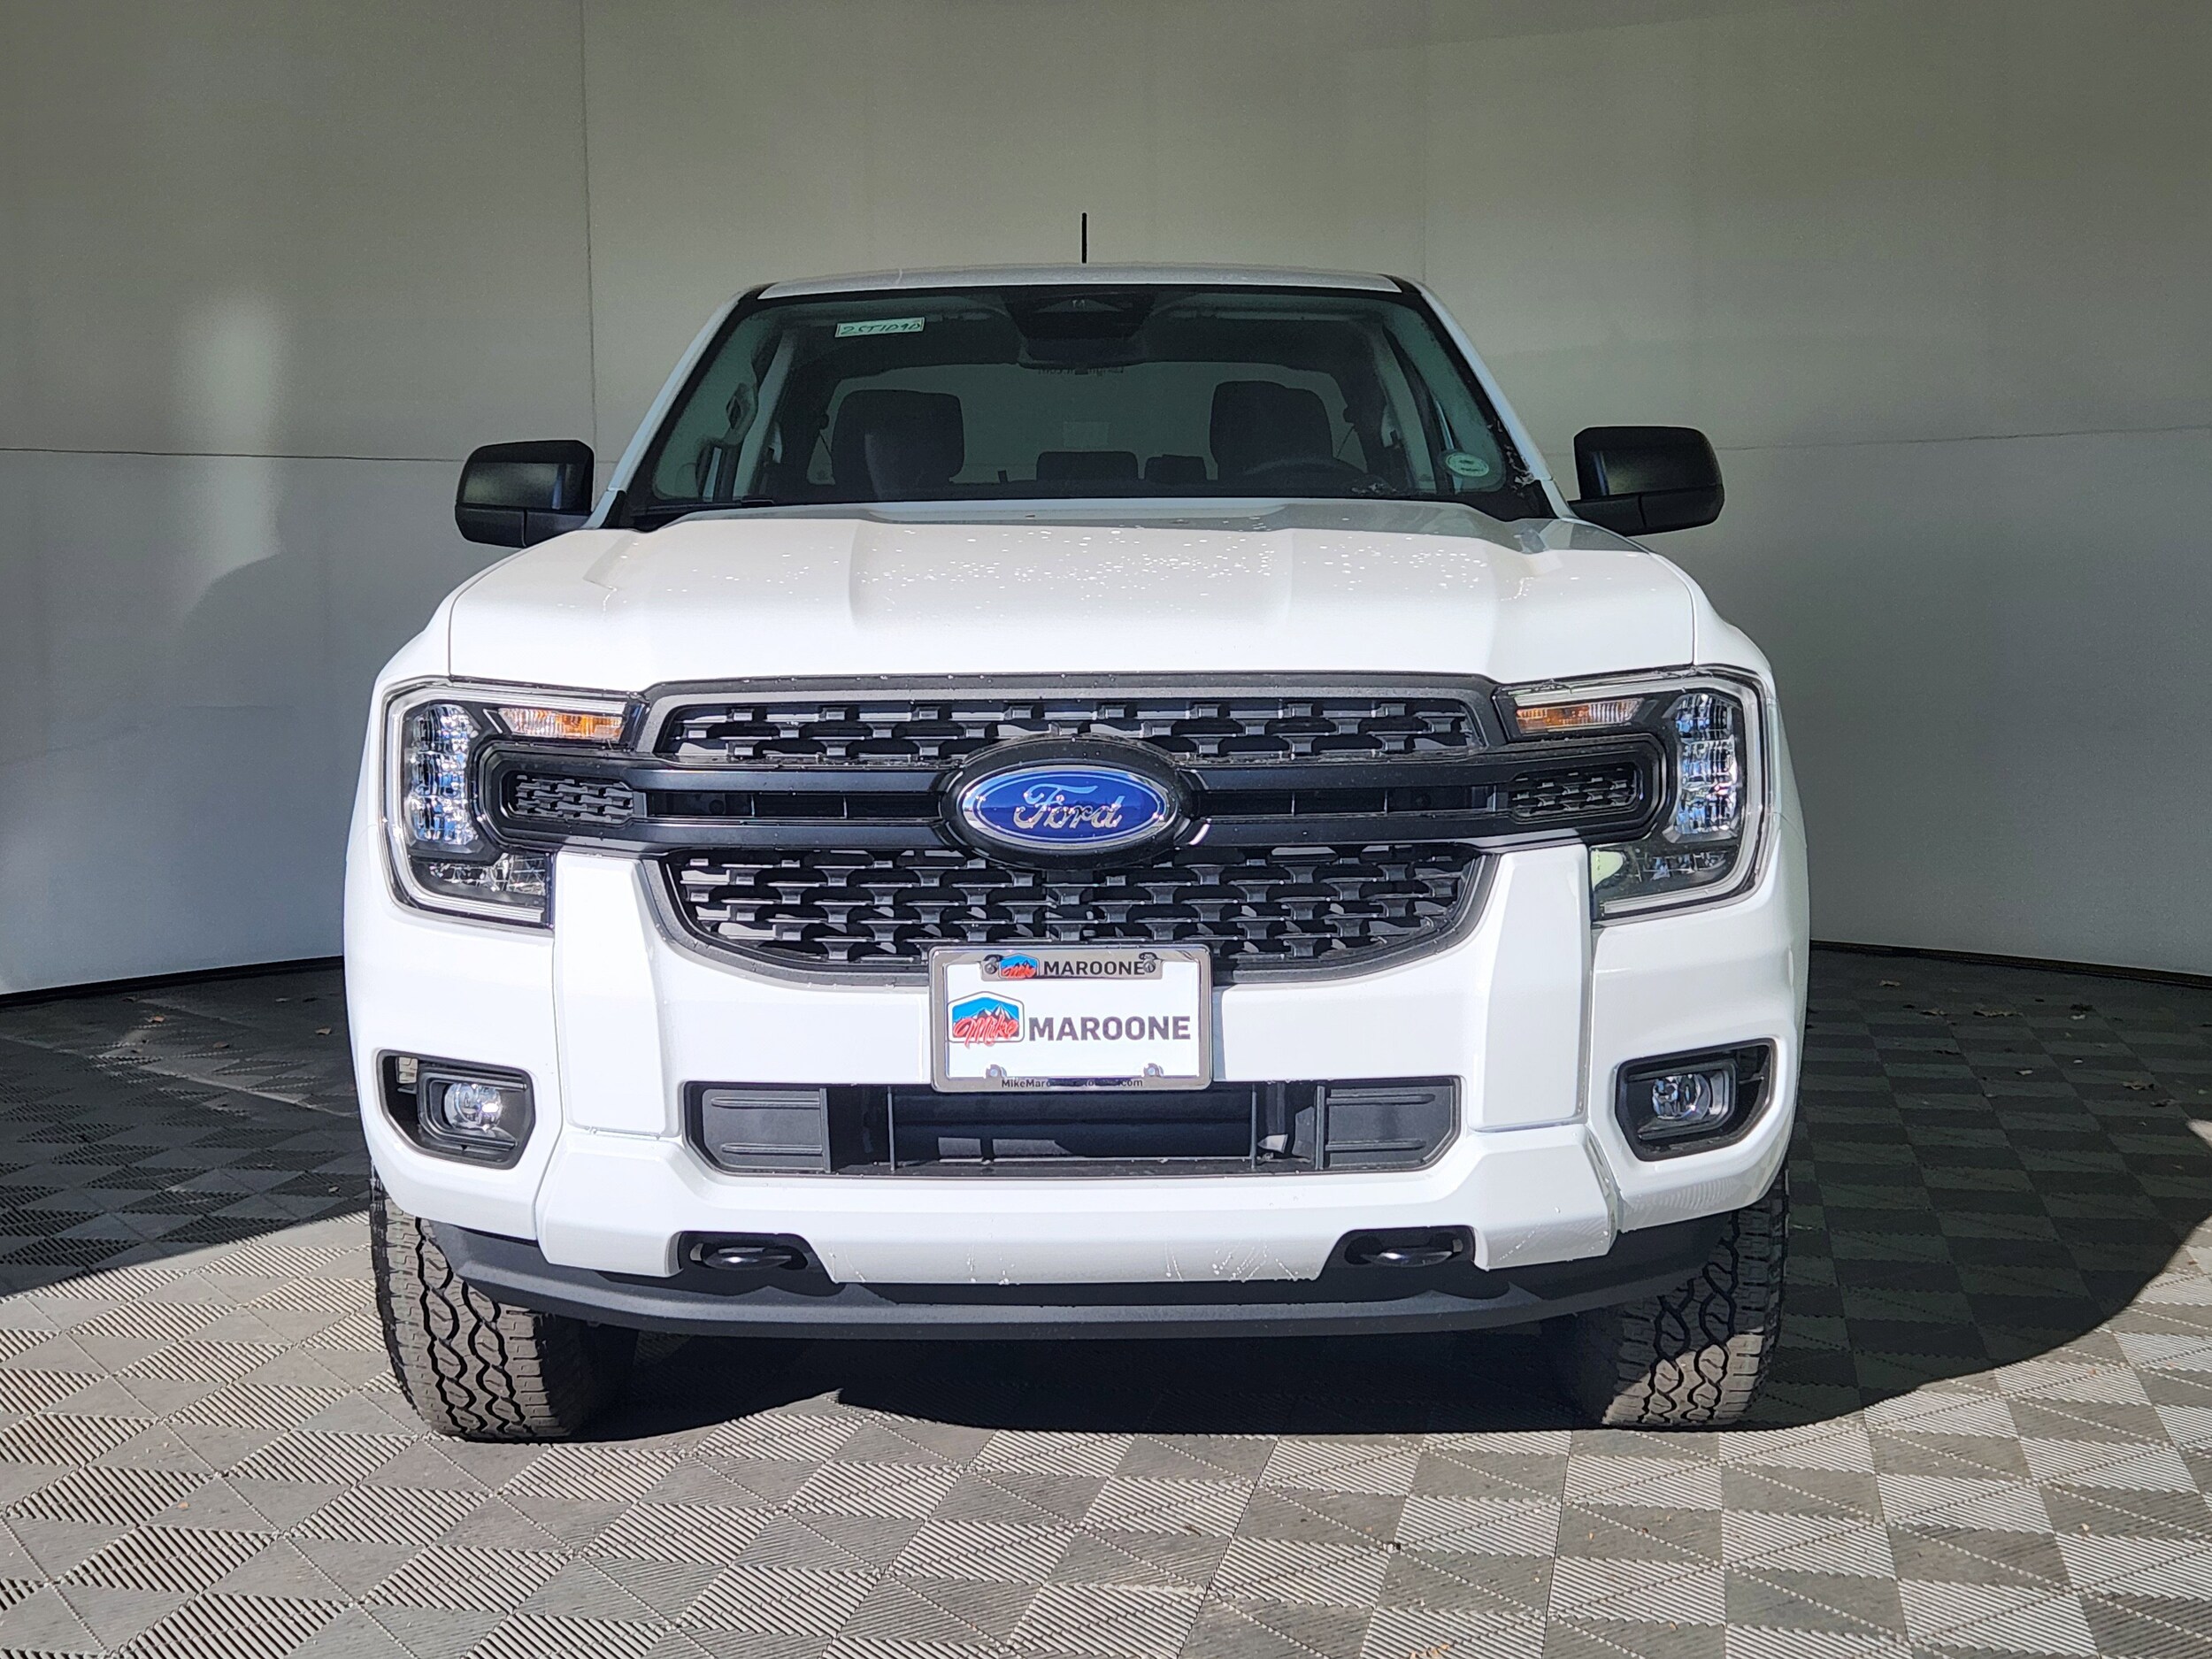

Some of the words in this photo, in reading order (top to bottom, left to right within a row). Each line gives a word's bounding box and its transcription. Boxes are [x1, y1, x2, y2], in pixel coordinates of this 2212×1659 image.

[1013, 783, 1125, 829] Ford
[1044, 961, 1145, 976] MAROONE
[953, 1012, 1019, 1048] Mike
[1028, 1016, 1190, 1041] MAROONE
